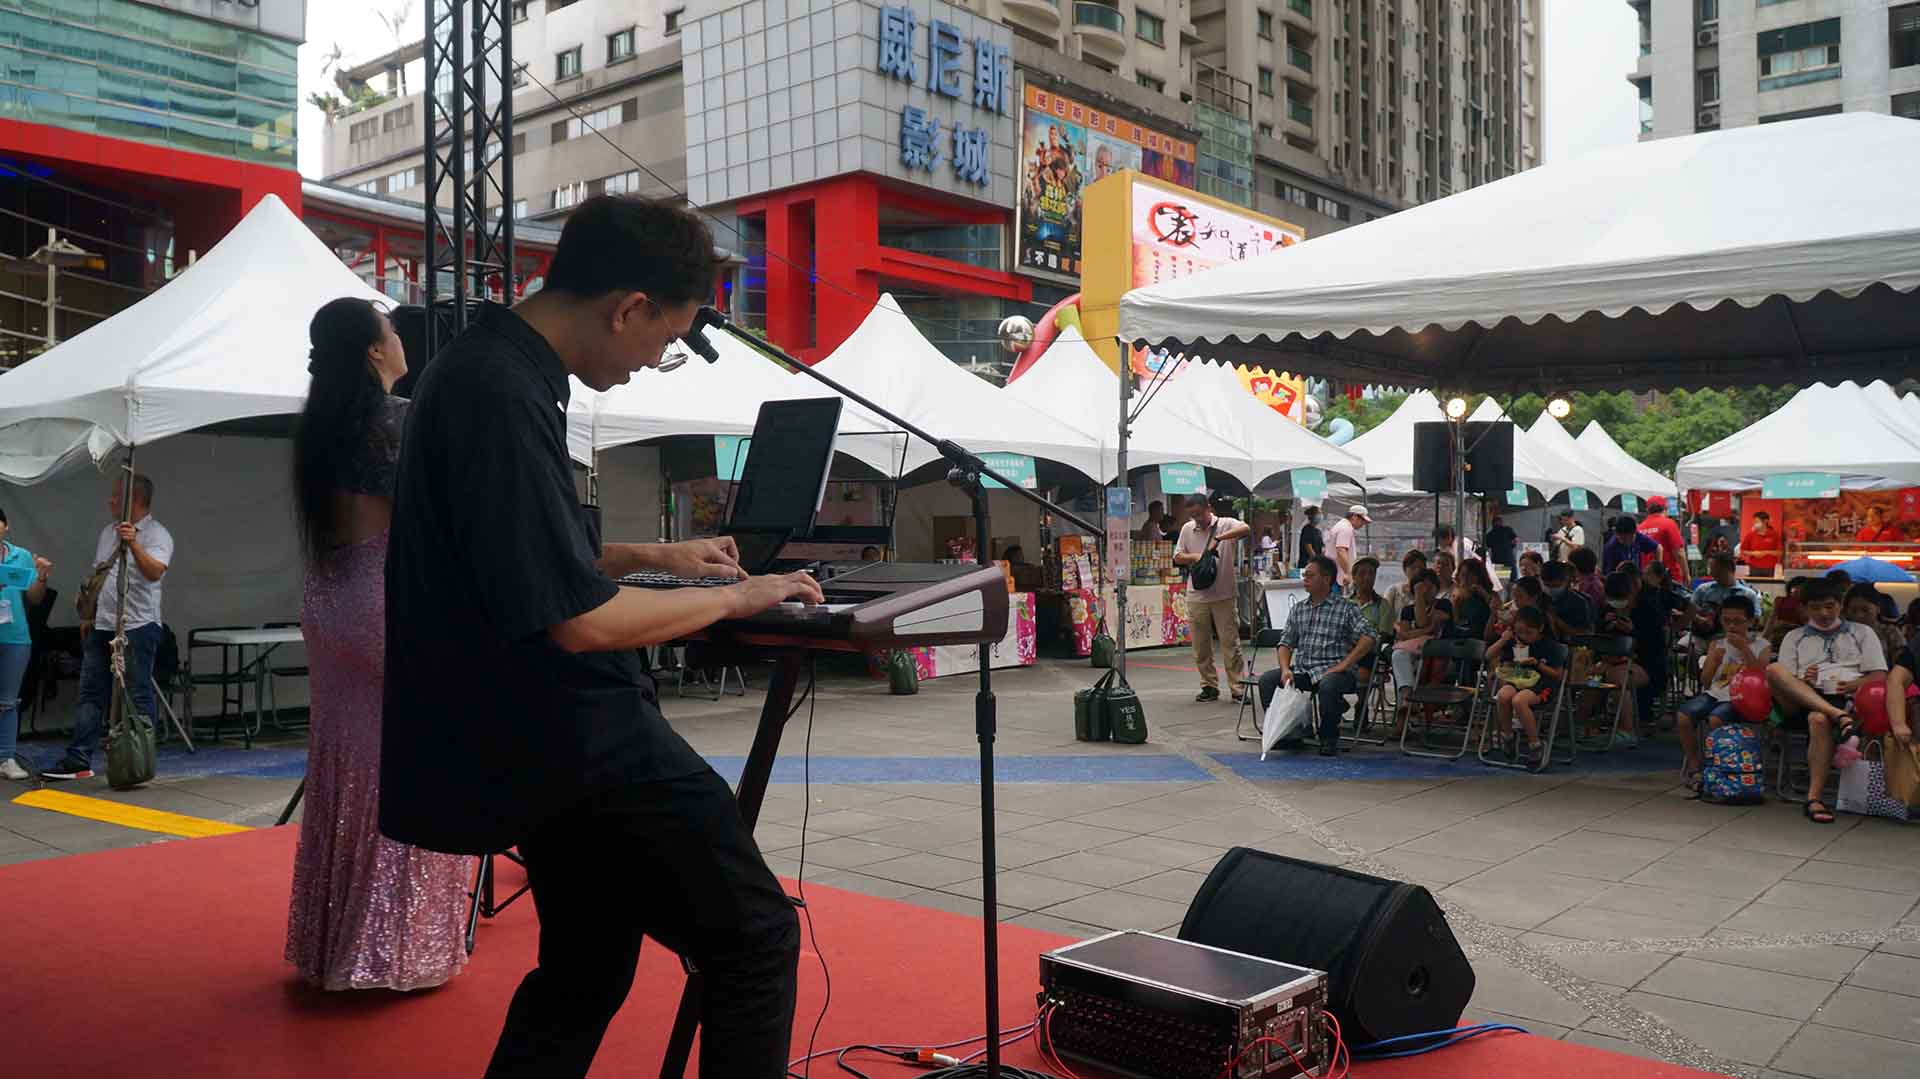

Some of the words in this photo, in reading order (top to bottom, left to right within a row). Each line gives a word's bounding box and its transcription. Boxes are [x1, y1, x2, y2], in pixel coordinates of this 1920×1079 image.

[877, 3, 1011, 115] 威尼斯
[900, 104, 991, 187] 影城
